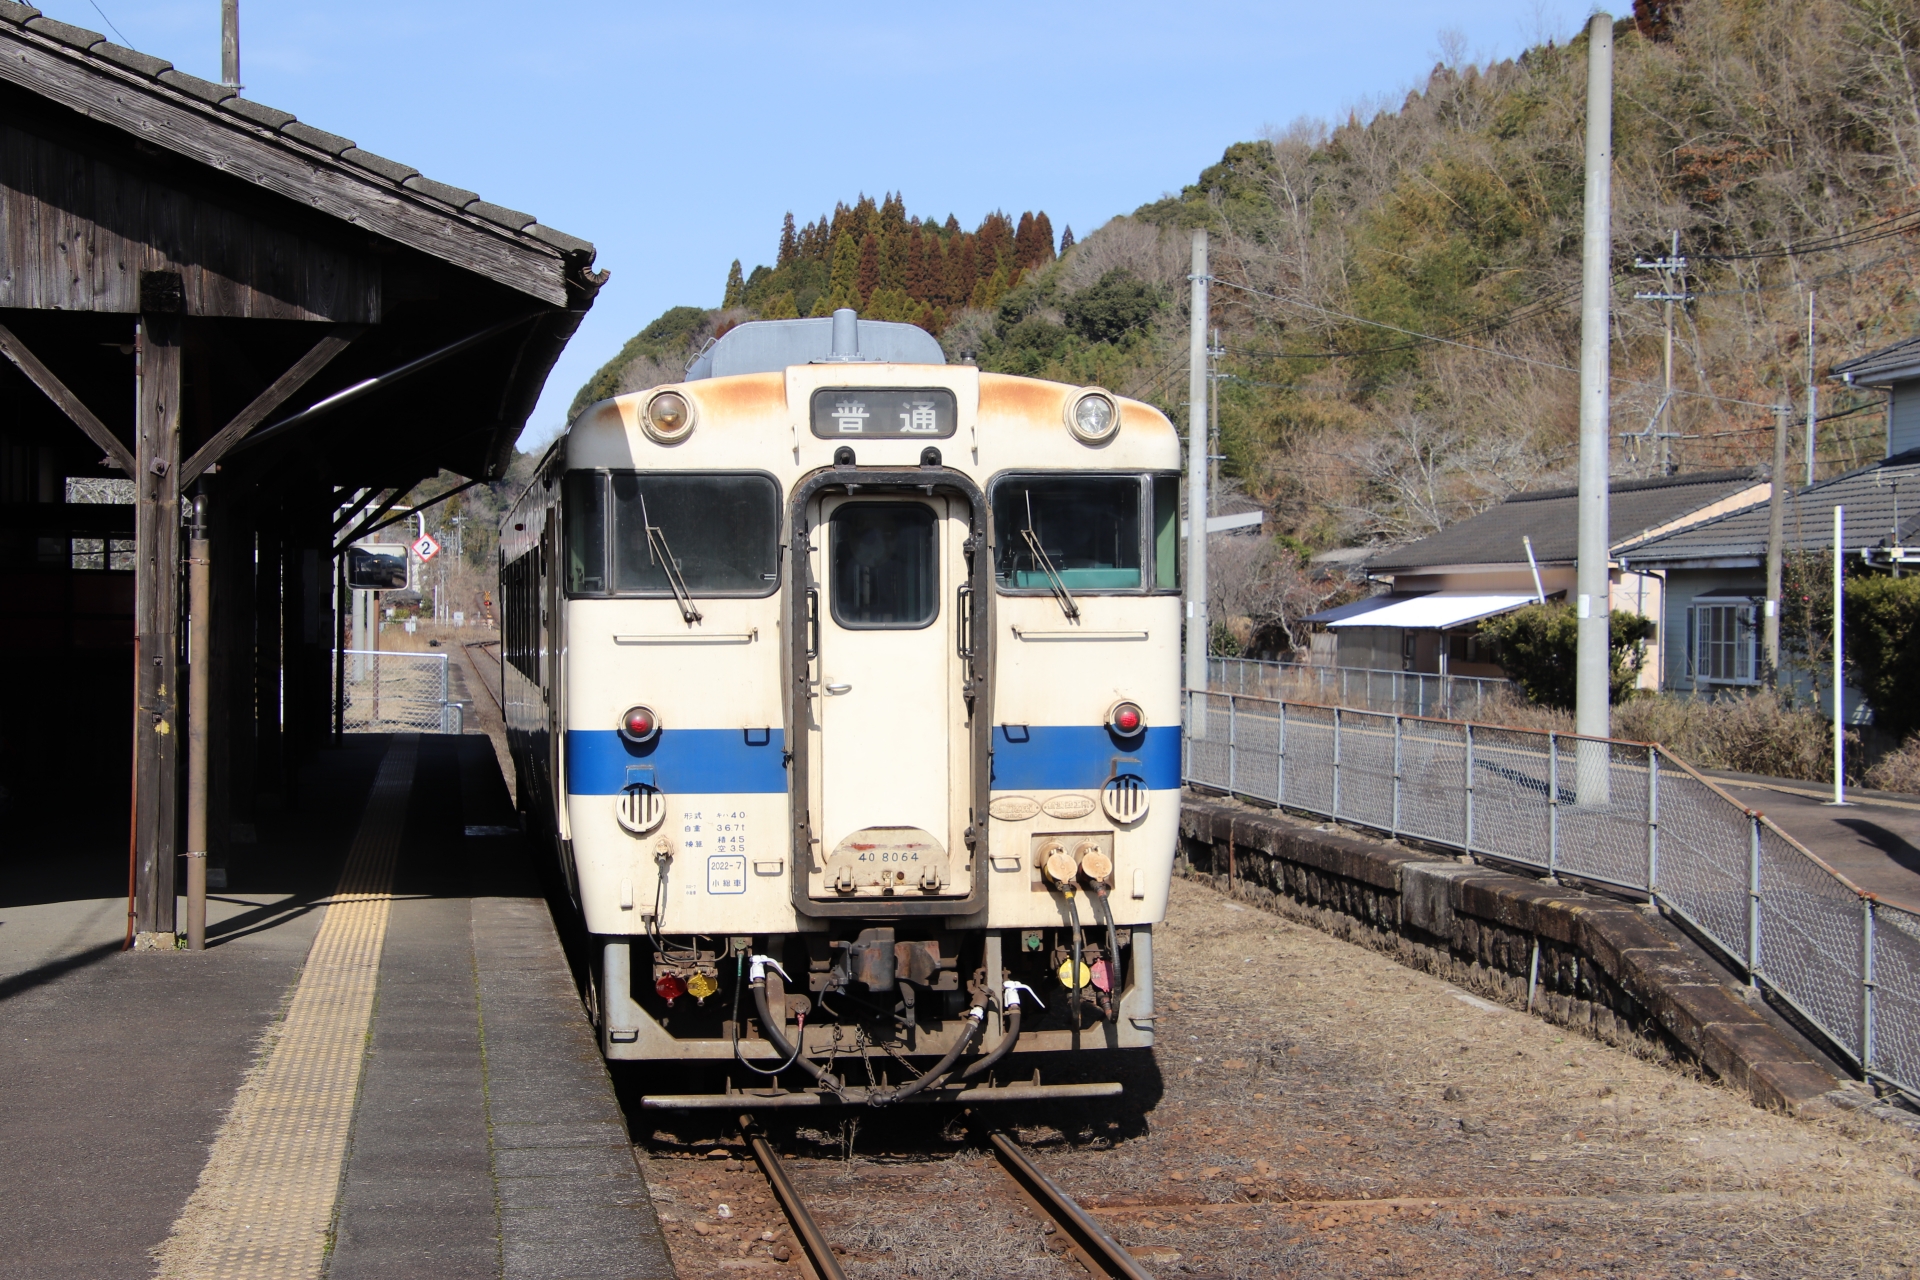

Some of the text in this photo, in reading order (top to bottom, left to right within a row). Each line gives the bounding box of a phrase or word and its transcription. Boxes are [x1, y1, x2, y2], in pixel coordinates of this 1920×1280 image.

[831, 399, 939, 433] 普通
[421, 541, 431, 555] 2
[684, 812, 702, 820] 形式
[858, 853, 919, 862] 40 8064
